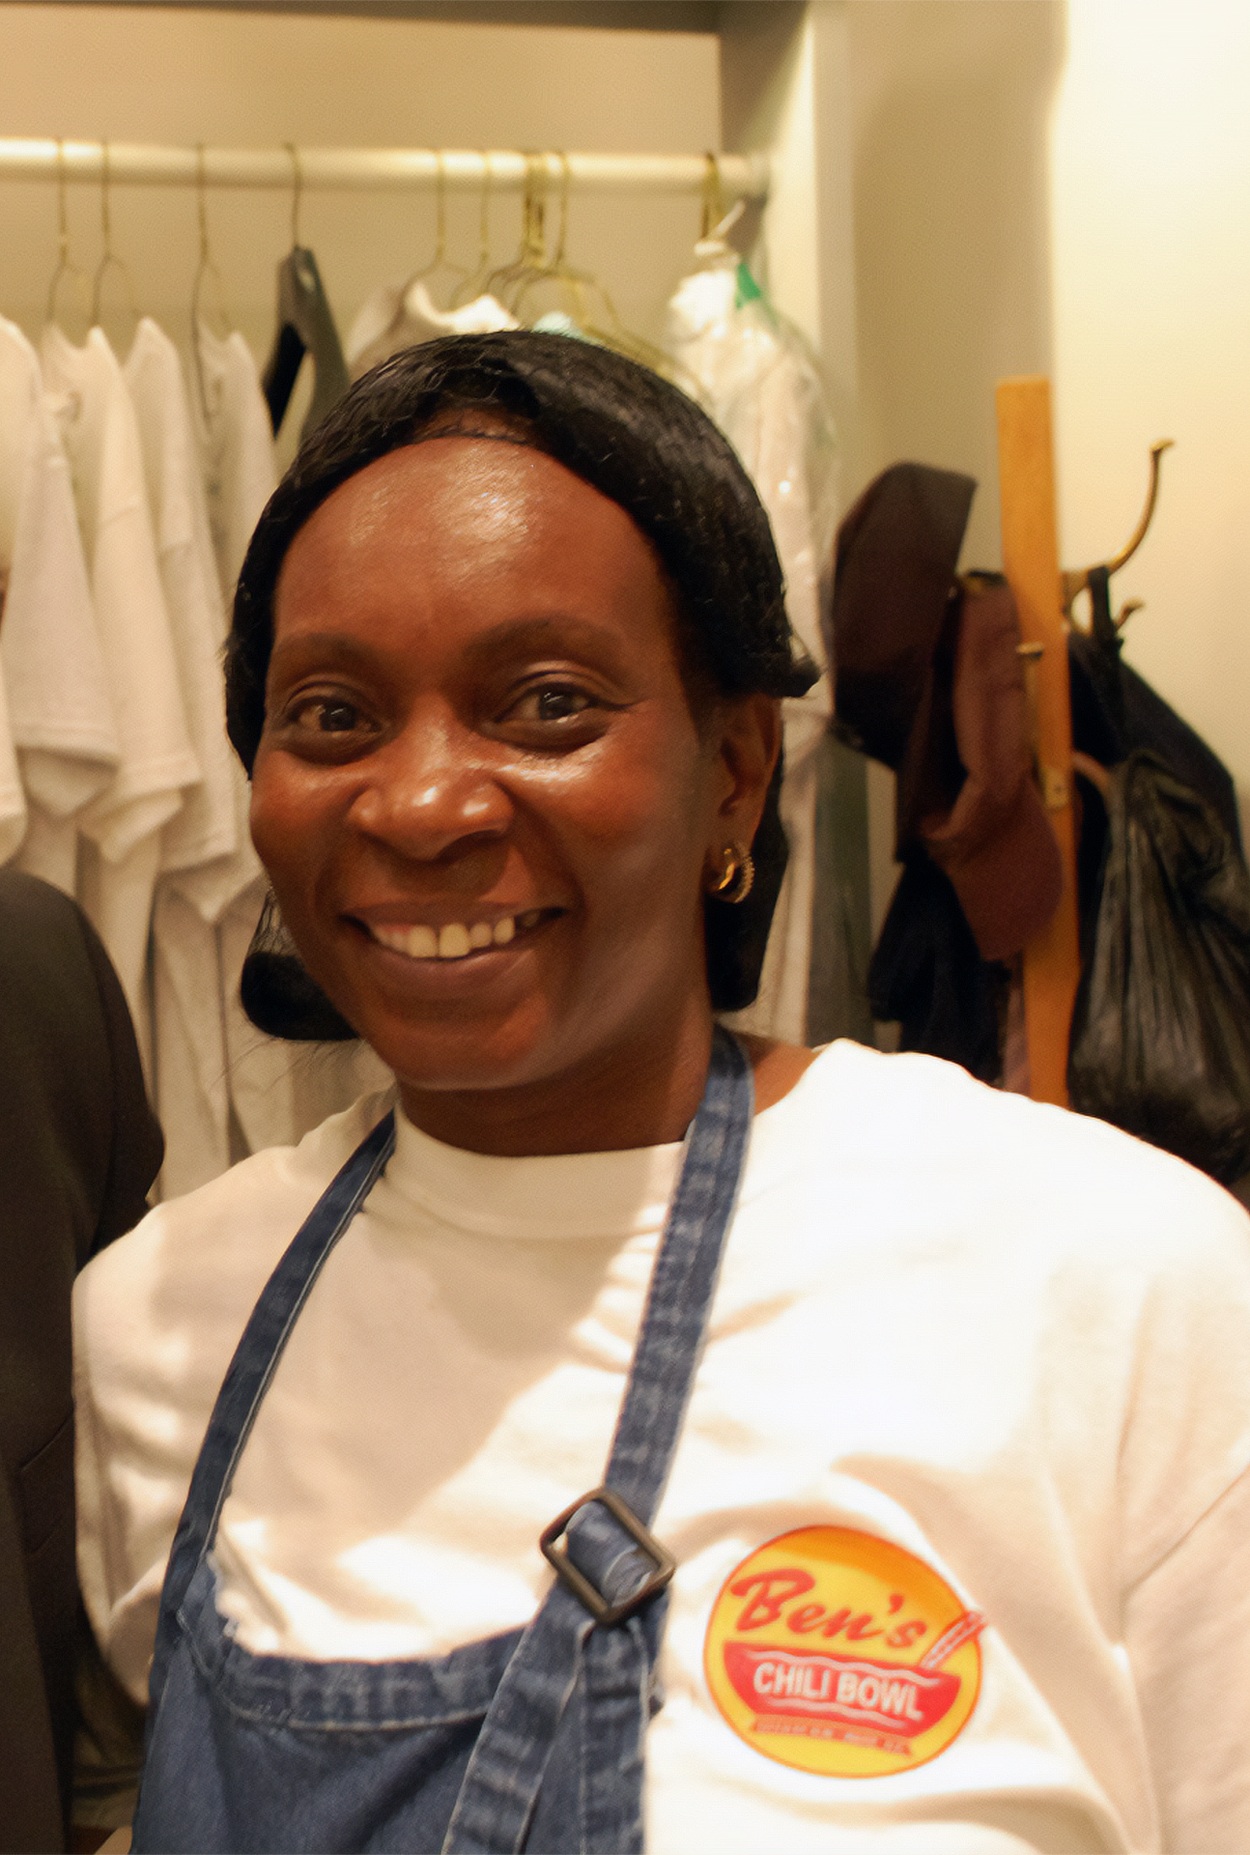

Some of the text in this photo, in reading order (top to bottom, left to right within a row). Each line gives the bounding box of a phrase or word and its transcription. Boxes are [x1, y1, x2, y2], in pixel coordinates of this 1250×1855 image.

[730, 1568, 927, 1648] Ben's
[753, 1661, 923, 1722] CHILI BOWL
